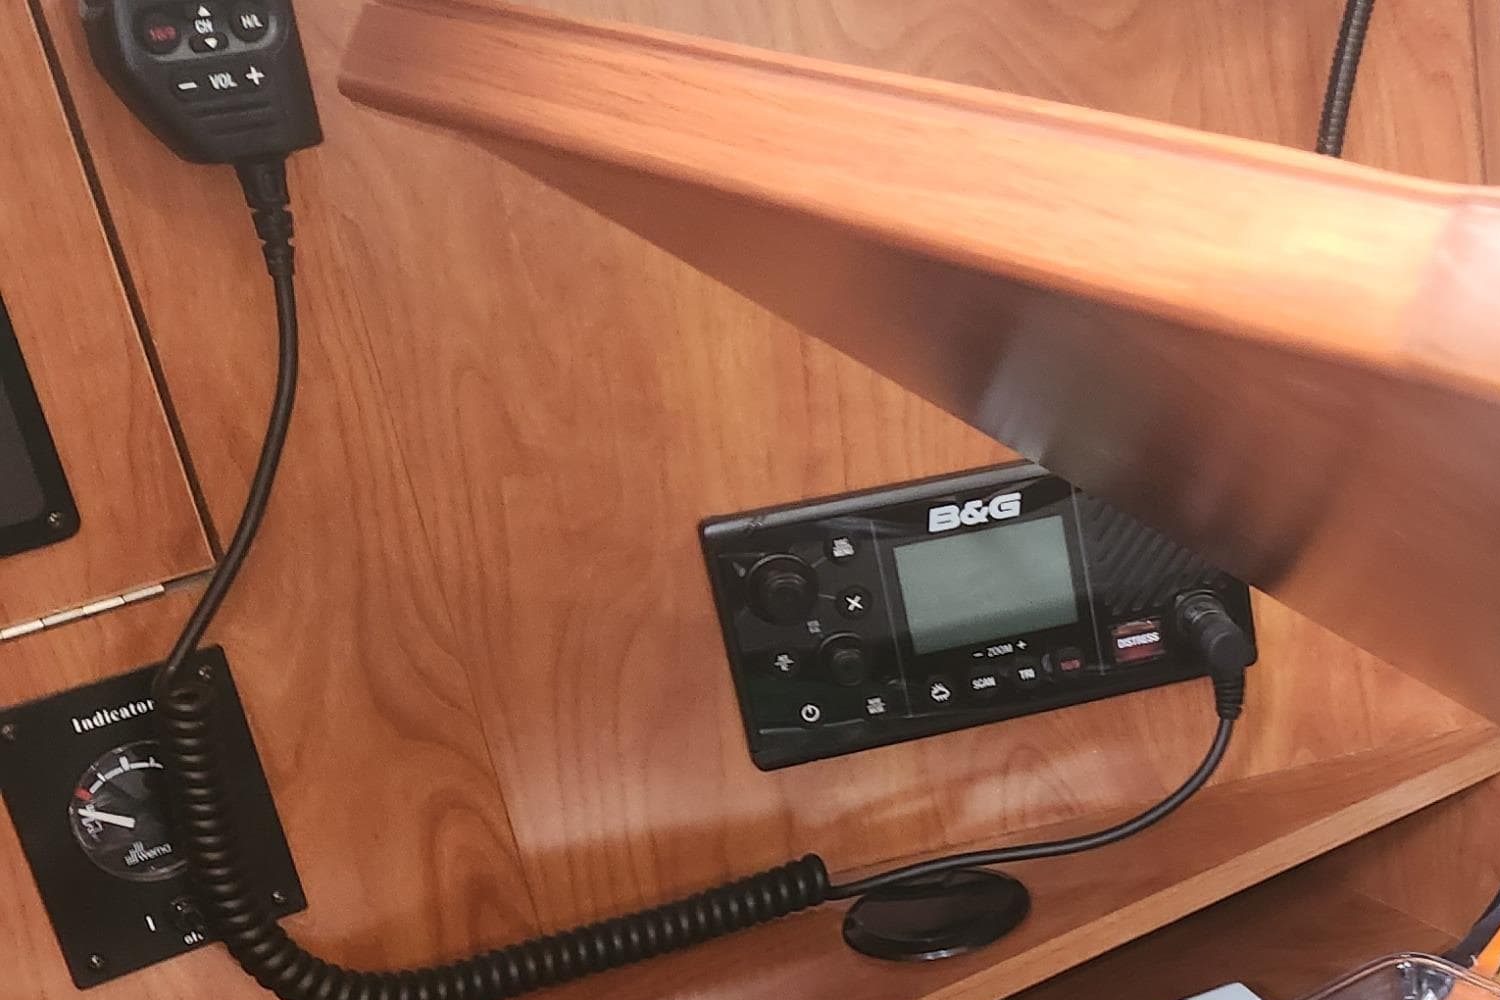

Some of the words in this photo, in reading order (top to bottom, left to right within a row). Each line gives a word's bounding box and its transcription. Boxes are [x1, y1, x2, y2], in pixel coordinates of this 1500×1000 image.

[208, 71, 238, 90] VOL
[928, 492, 1022, 533] B&G
[71, 698, 156, 733] Indicator
